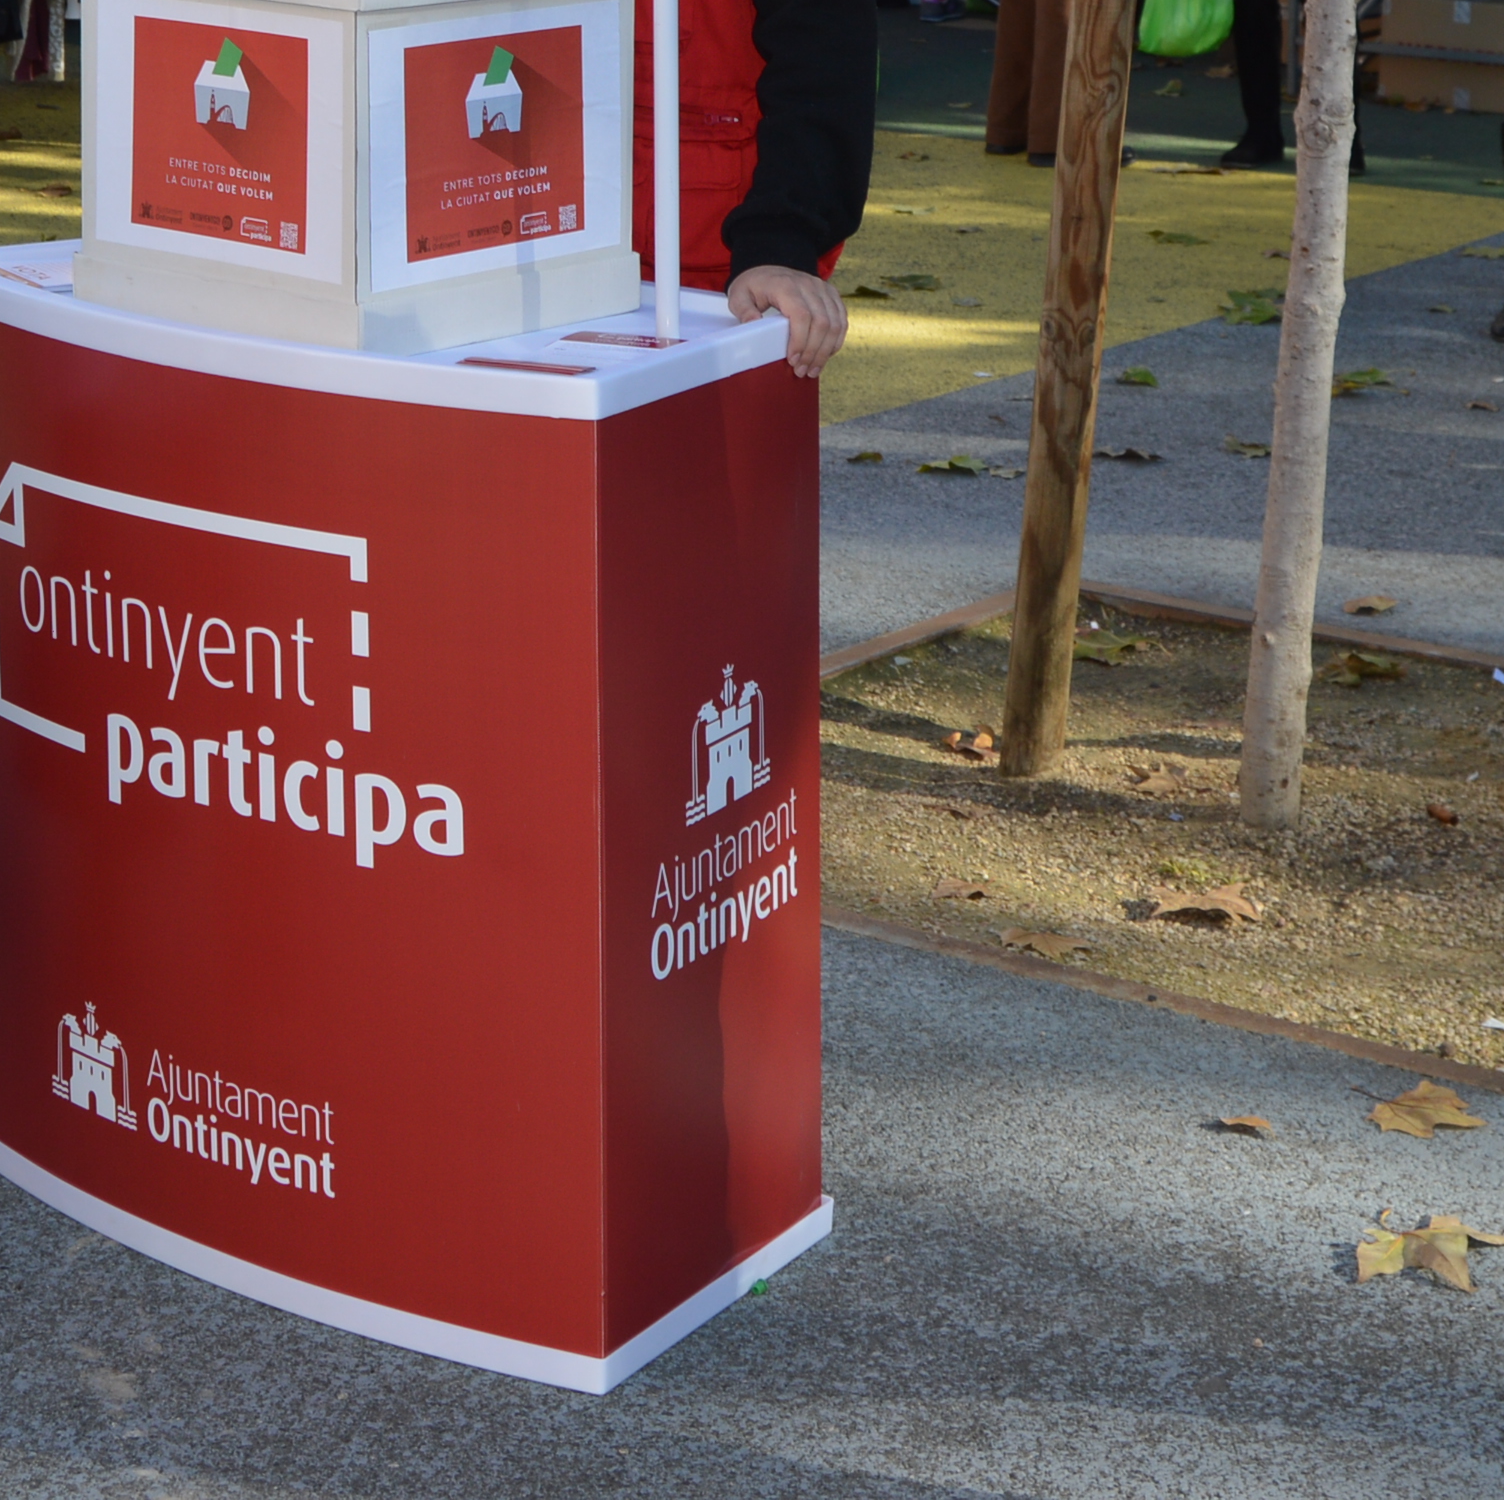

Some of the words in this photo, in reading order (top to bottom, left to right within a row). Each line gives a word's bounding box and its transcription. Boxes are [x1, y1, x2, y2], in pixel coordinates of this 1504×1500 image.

[165, 174, 178, 185] LA
[180, 176, 214, 191] CIUTAT
[216, 182, 237, 196] QUE
[240, 186, 274, 201] VOLEM
[169, 157, 199, 172] ENTRE
[202, 161, 226, 176] TOTS
[229, 166, 271, 183] DECIDIM
[440, 199, 453, 210] LA
[456, 192, 490, 207] CIUTAT
[493, 187, 514, 200] QUE
[517, 182, 551, 196] VOLEM
[443, 177, 474, 192] ENTRE
[477, 173, 502, 186] TOTS
[505, 165, 548, 182] DECIDIM
[21, 566, 315, 706] ontinyent
[108, 713, 465, 869] participa
[651, 788, 798, 919] Ajuntament
[651, 848, 798, 981] Ontinyent
[146, 1048, 335, 1145] Ajuntament
[147, 1098, 336, 1199] Ontinyent
